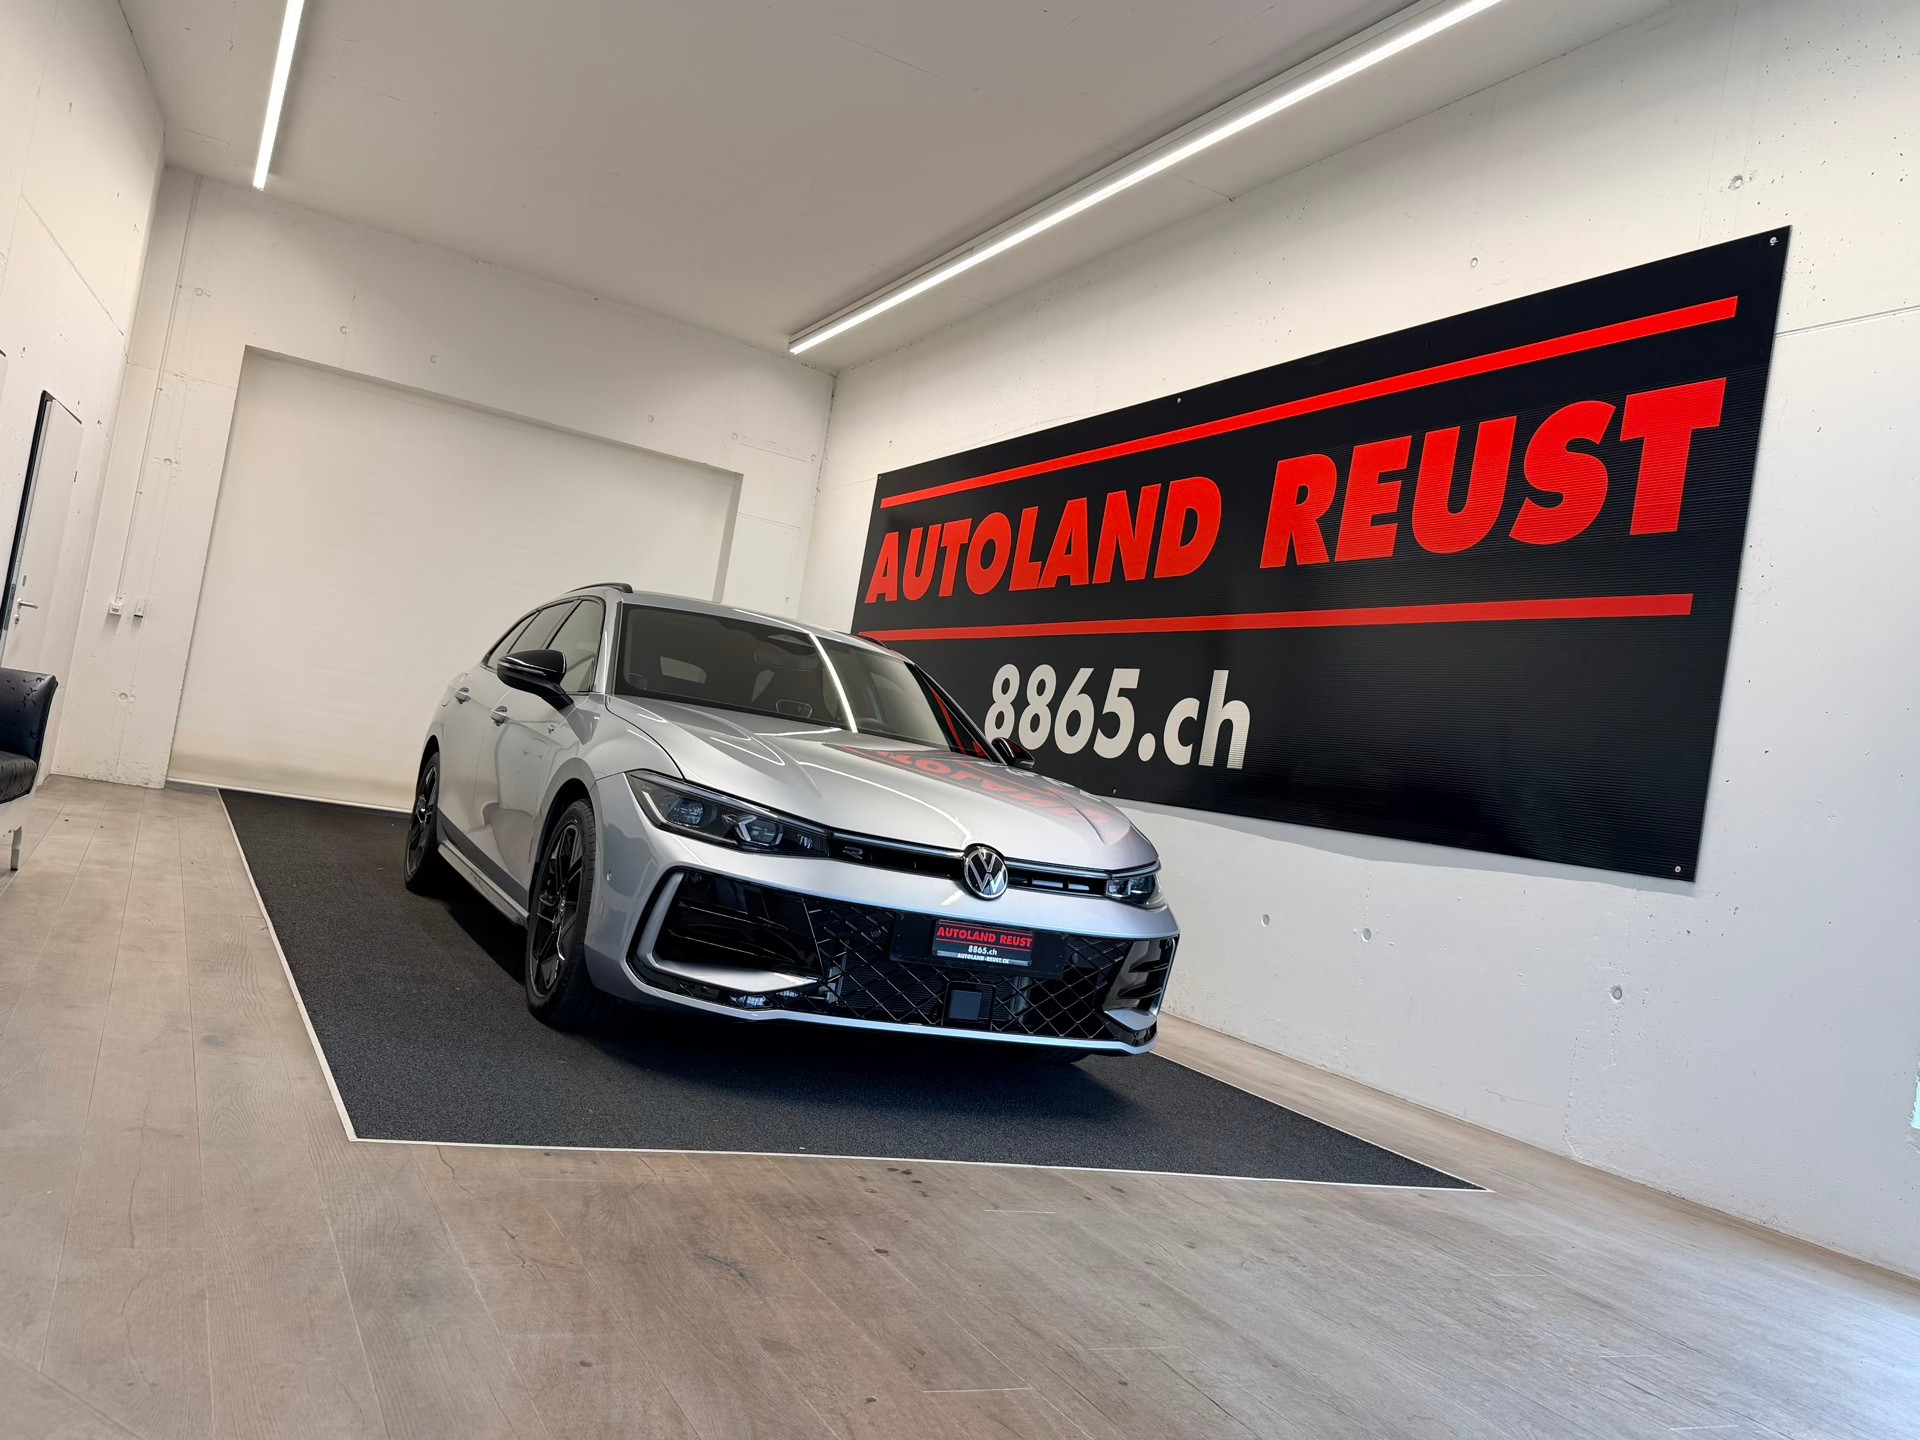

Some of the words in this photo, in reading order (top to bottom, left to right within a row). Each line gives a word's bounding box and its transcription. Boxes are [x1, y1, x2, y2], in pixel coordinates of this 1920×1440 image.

[864, 475, 1222, 604] AUTOLAND
[1259, 377, 1727, 569] REUST
[984, 663, 1251, 769] 8865.ch
[936, 926, 997, 943] AUTOLAND
[1000, 934, 1033, 948] REUST
[968, 944, 998, 956] 8865.ch
